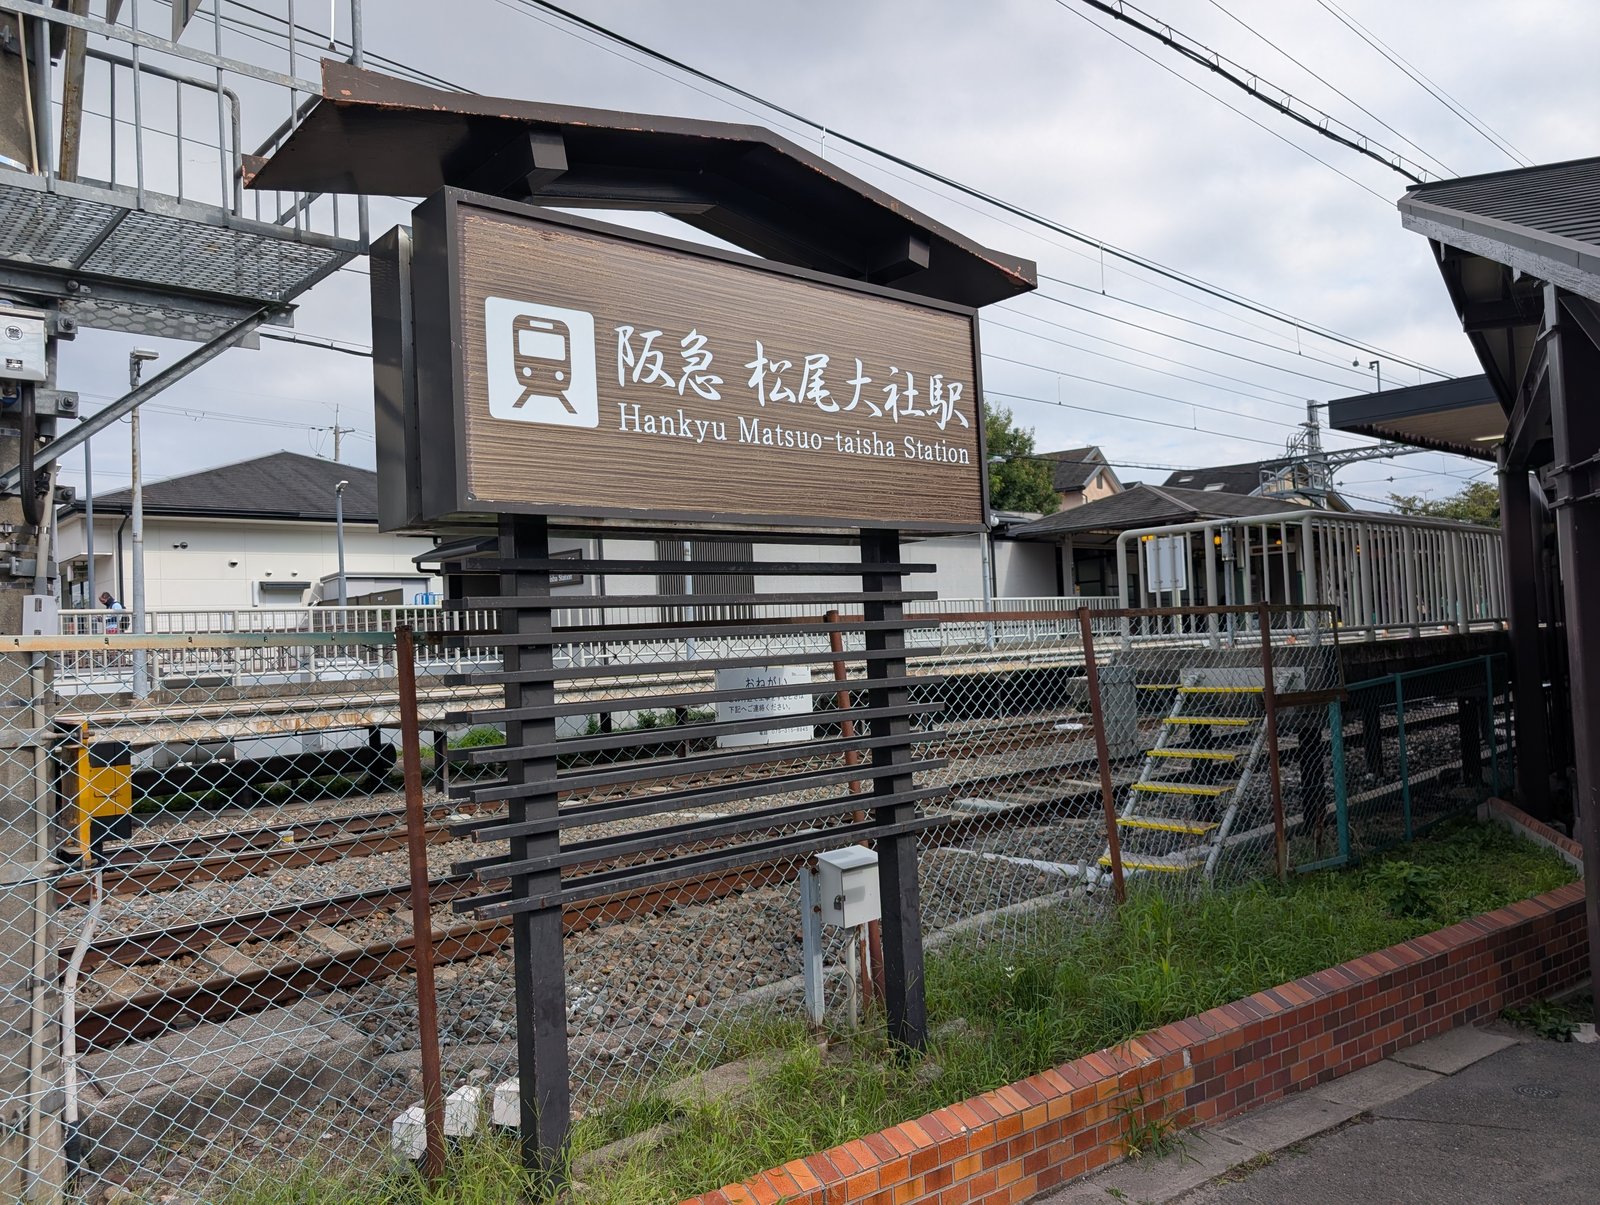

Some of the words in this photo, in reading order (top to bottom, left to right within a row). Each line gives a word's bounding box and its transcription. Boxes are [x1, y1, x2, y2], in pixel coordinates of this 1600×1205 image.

[613, 325, 725, 401] 阪急
[745, 338, 970, 432] 松尾大社駅
[617, 402, 727, 444] Hankyu
[738, 415, 896, 457] Matsuo-taisha
[903, 436, 970, 465] Station
[745, 676, 788, 689] おねがい
